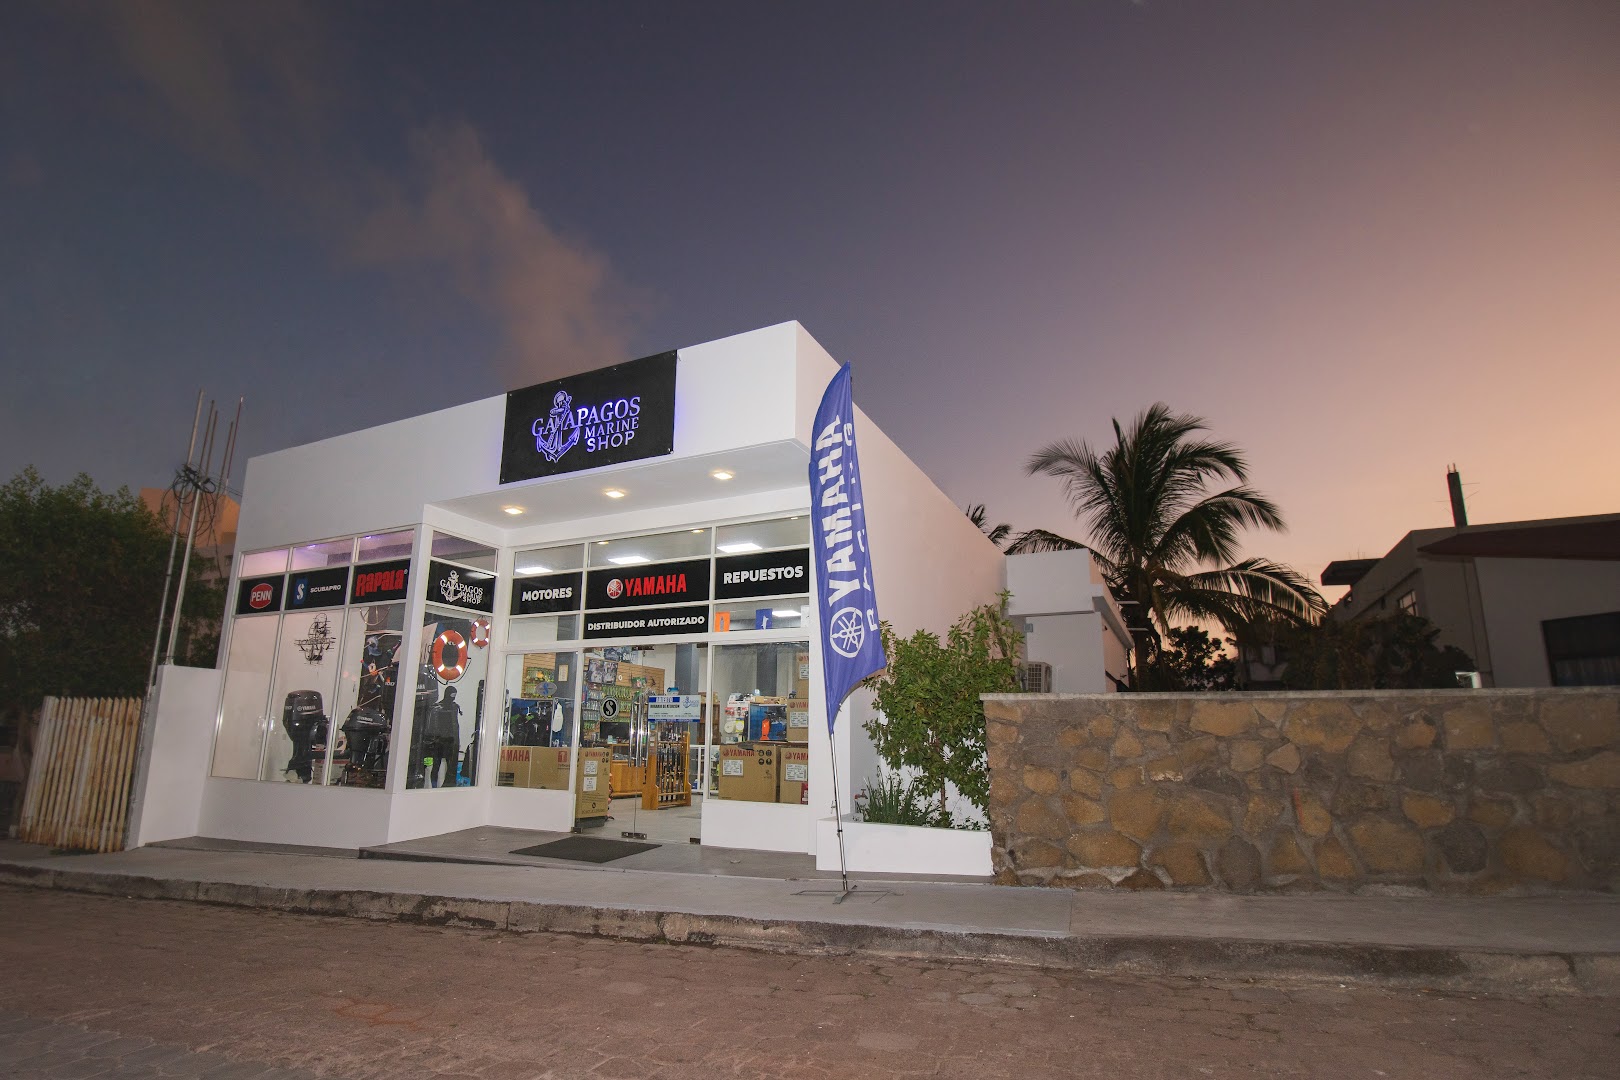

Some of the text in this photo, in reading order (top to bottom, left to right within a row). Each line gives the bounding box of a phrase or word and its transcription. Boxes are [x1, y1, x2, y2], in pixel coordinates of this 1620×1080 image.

[532, 396, 641, 437] GAAPAGOS
[585, 416, 639, 439] MARINE
[586, 430, 635, 453] SHOP
[815, 414, 861, 608] YAMAHA
[723, 565, 804, 584] REPUESTOS
[310, 584, 342, 593] SCUBAPRO
[440, 579, 484, 596] GAAPAGOS
[624, 573, 687, 597] YAMAHA
[251, 590, 272, 602] PENN
[463, 596, 481, 605] SHOP
[522, 586, 573, 602] MOTORES
[587, 616, 705, 631] DISTRIBUIDOR AUTORIZADO
[500, 750, 530, 762] AMAHA
[729, 749, 755, 757] YAMAHA
